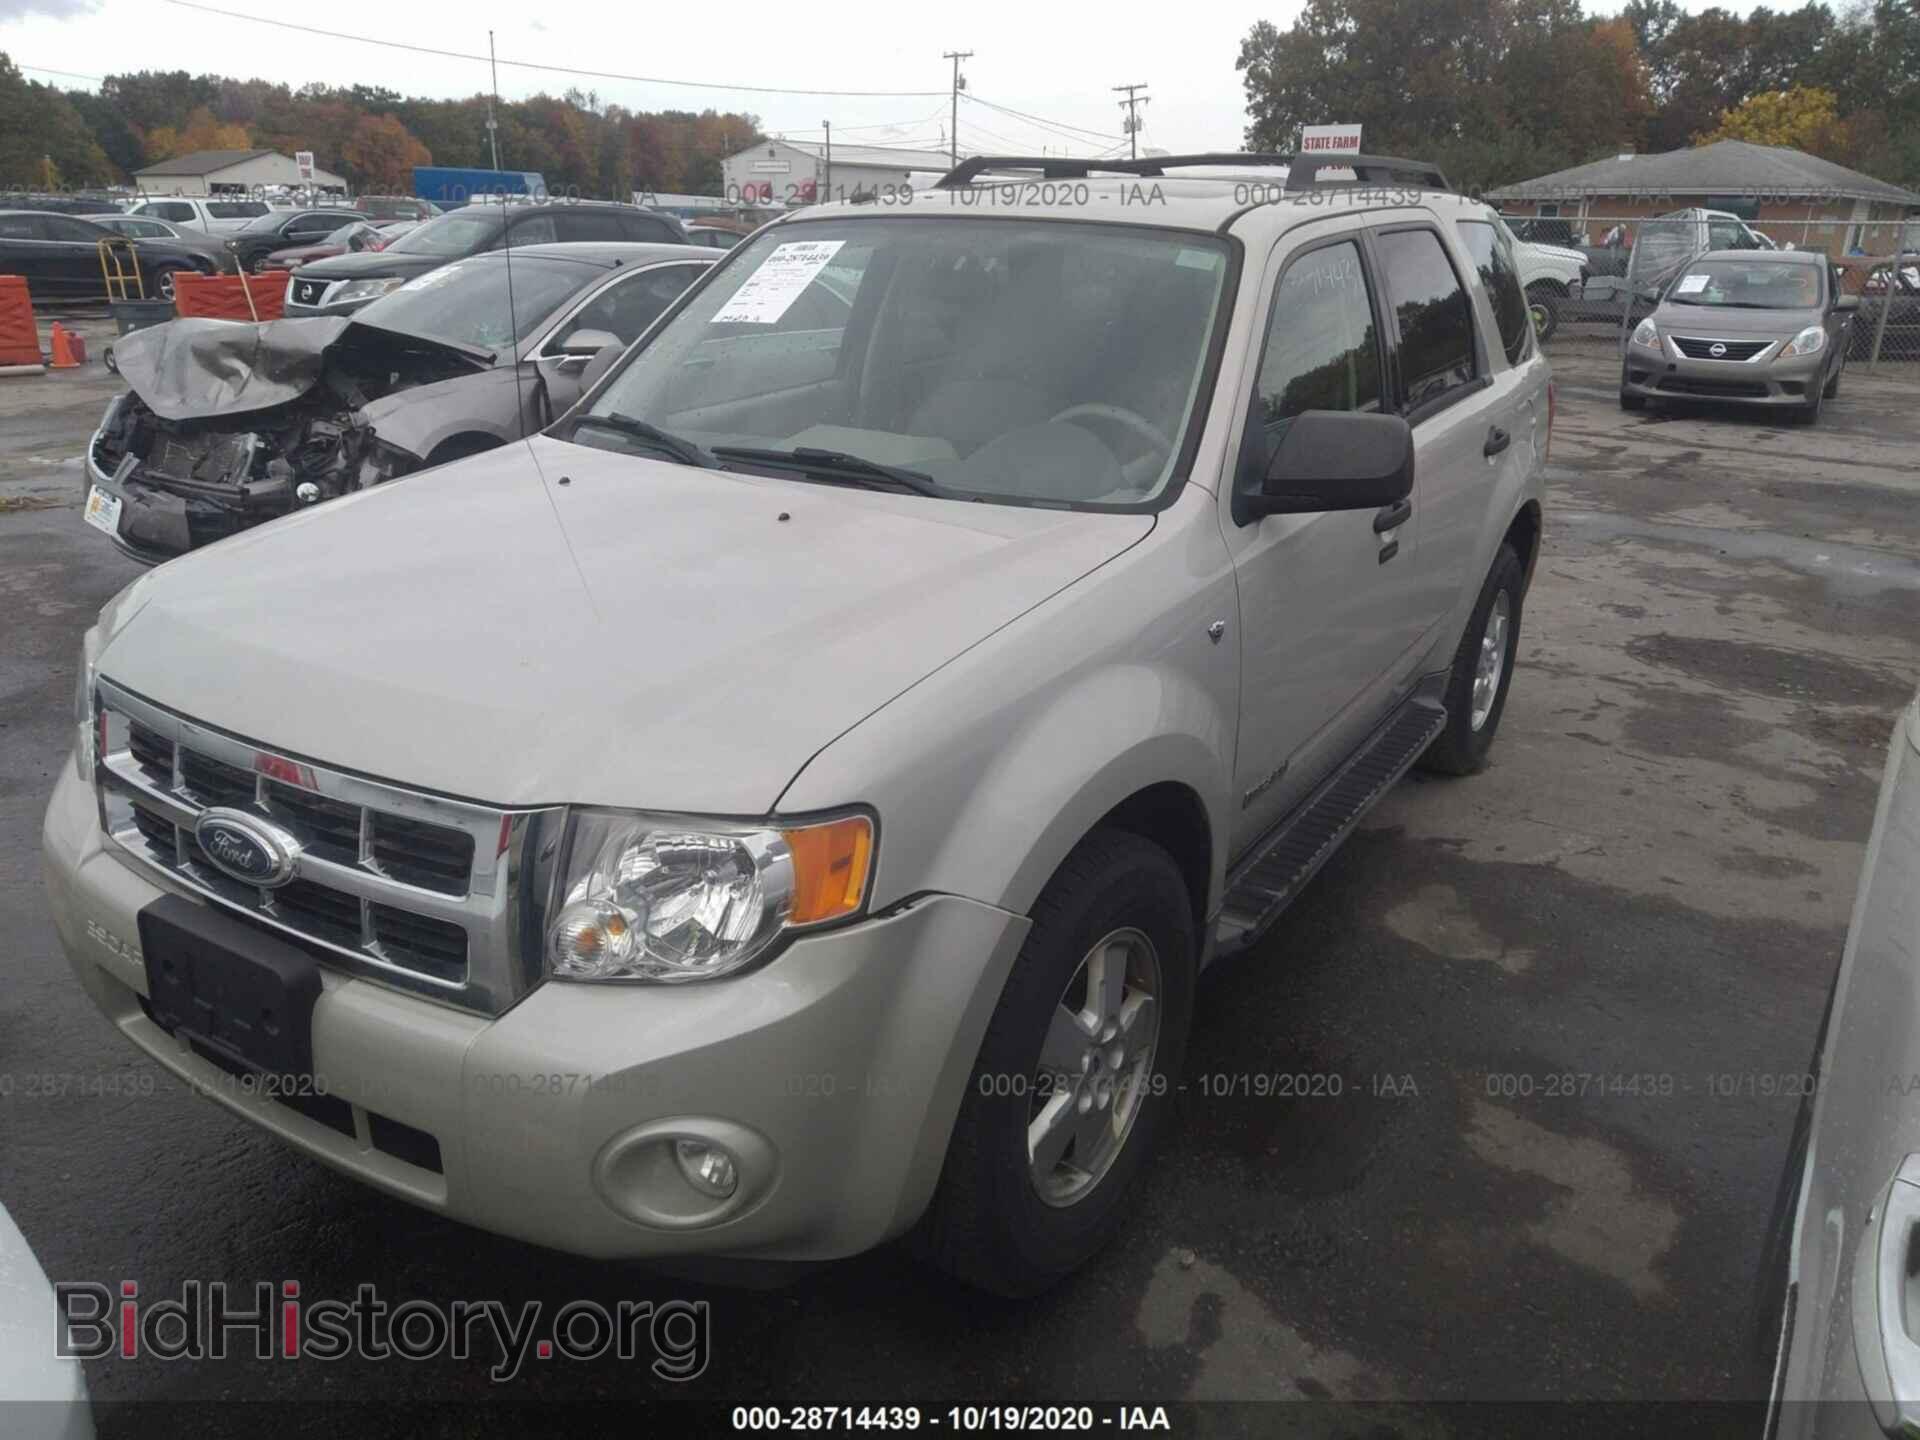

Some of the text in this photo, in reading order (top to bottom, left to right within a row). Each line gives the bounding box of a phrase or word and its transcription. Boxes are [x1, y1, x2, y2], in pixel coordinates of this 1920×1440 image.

[1304, 136, 1358, 150] STATE FARM
[209, 829, 253, 868] Ford
[87, 919, 144, 966] ESCAP
